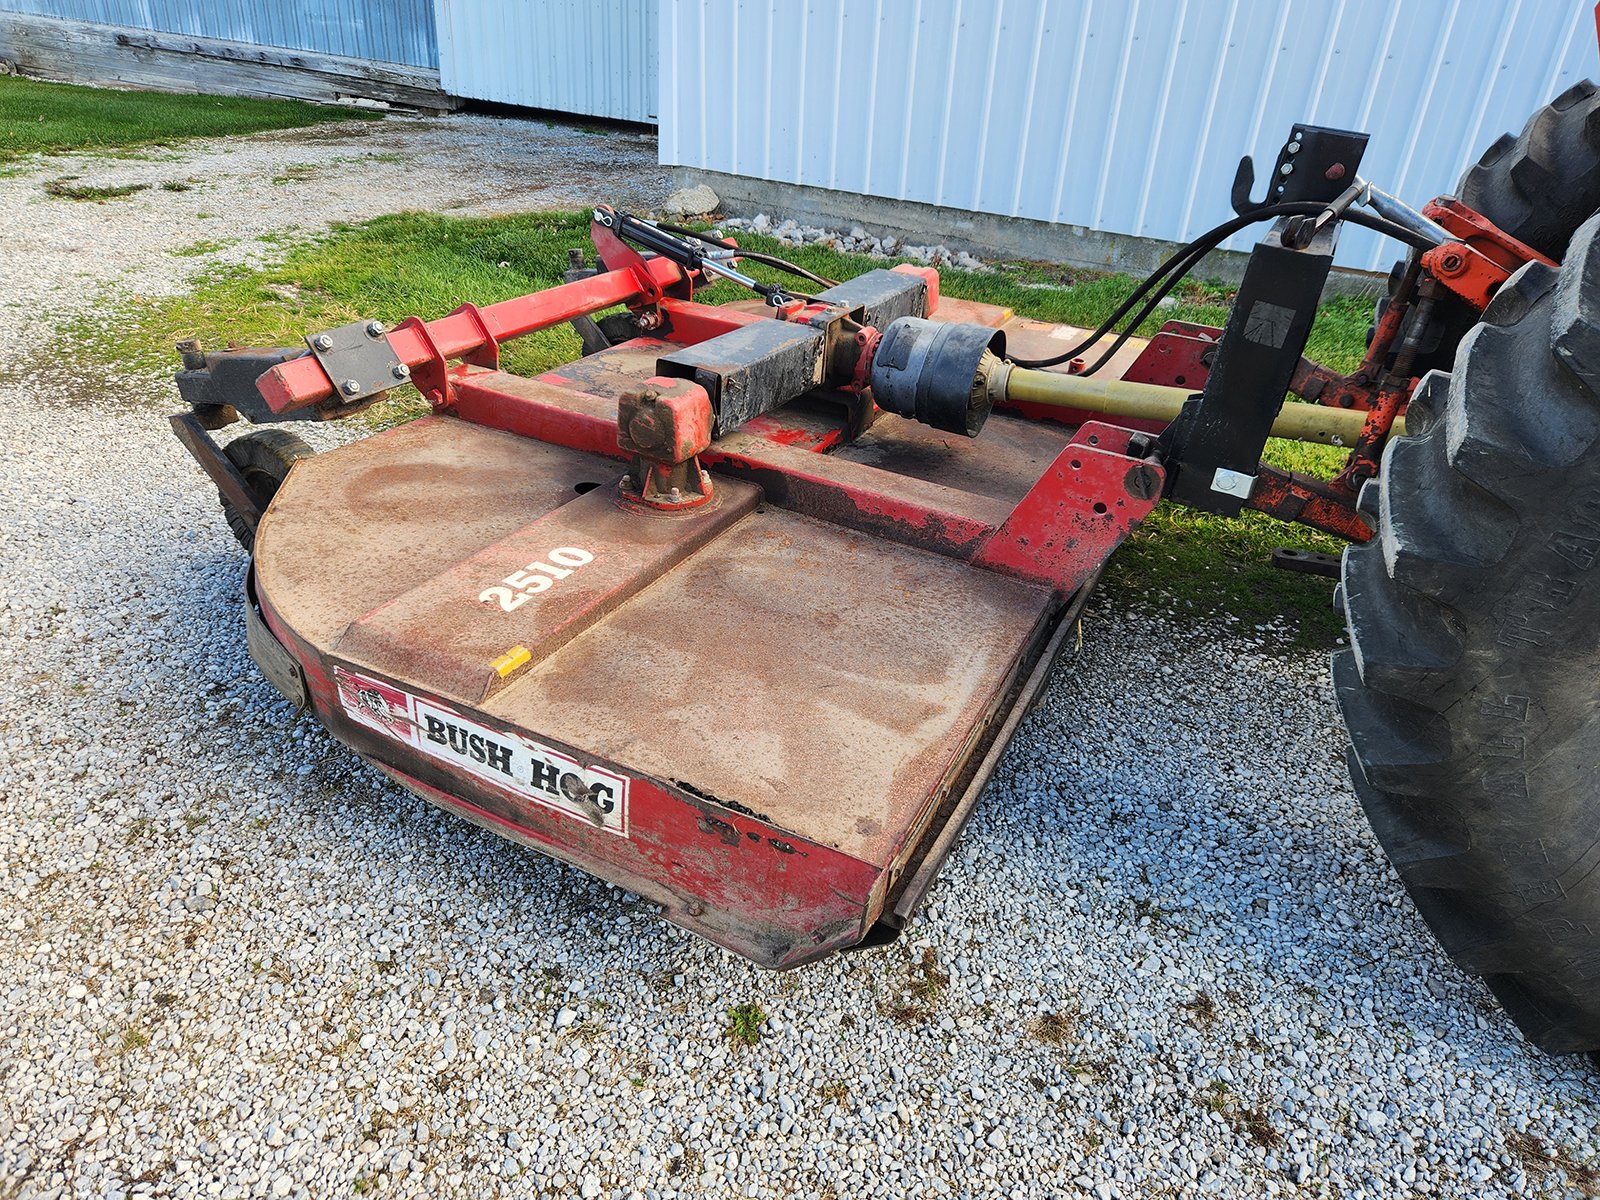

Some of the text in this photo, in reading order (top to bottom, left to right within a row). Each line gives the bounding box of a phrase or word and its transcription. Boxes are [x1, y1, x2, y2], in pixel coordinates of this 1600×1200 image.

[479, 547, 594, 613] 2510
[424, 713, 615, 815] BUSH HOG
